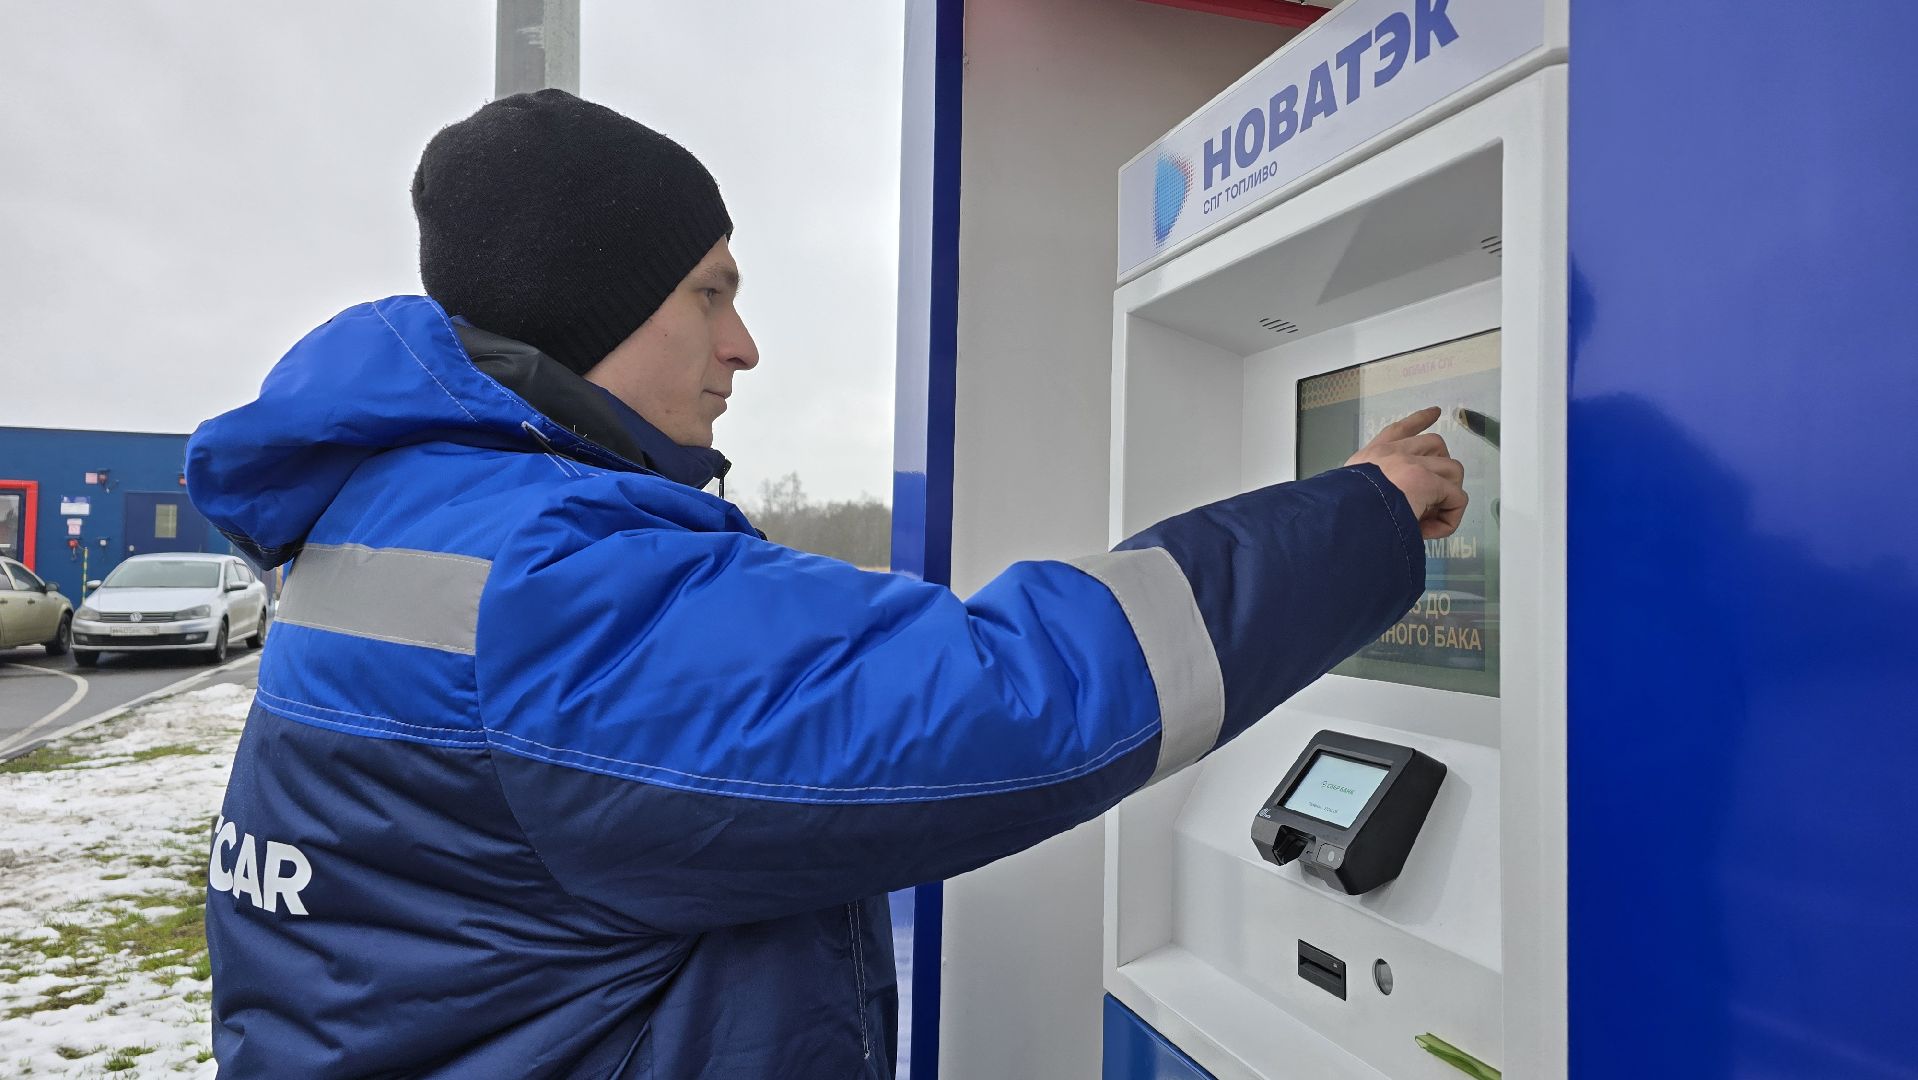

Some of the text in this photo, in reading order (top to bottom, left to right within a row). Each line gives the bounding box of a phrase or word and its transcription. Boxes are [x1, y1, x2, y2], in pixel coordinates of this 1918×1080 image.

[1203, 0, 1459, 190] НОВАТЭК
[1203, 161, 1278, 215] СПГ ТОПЛИВО
[1425, 592, 1451, 619] ДО
[1381, 623, 1482, 651] НОГО БАКА
[210, 815, 312, 915] CAR
